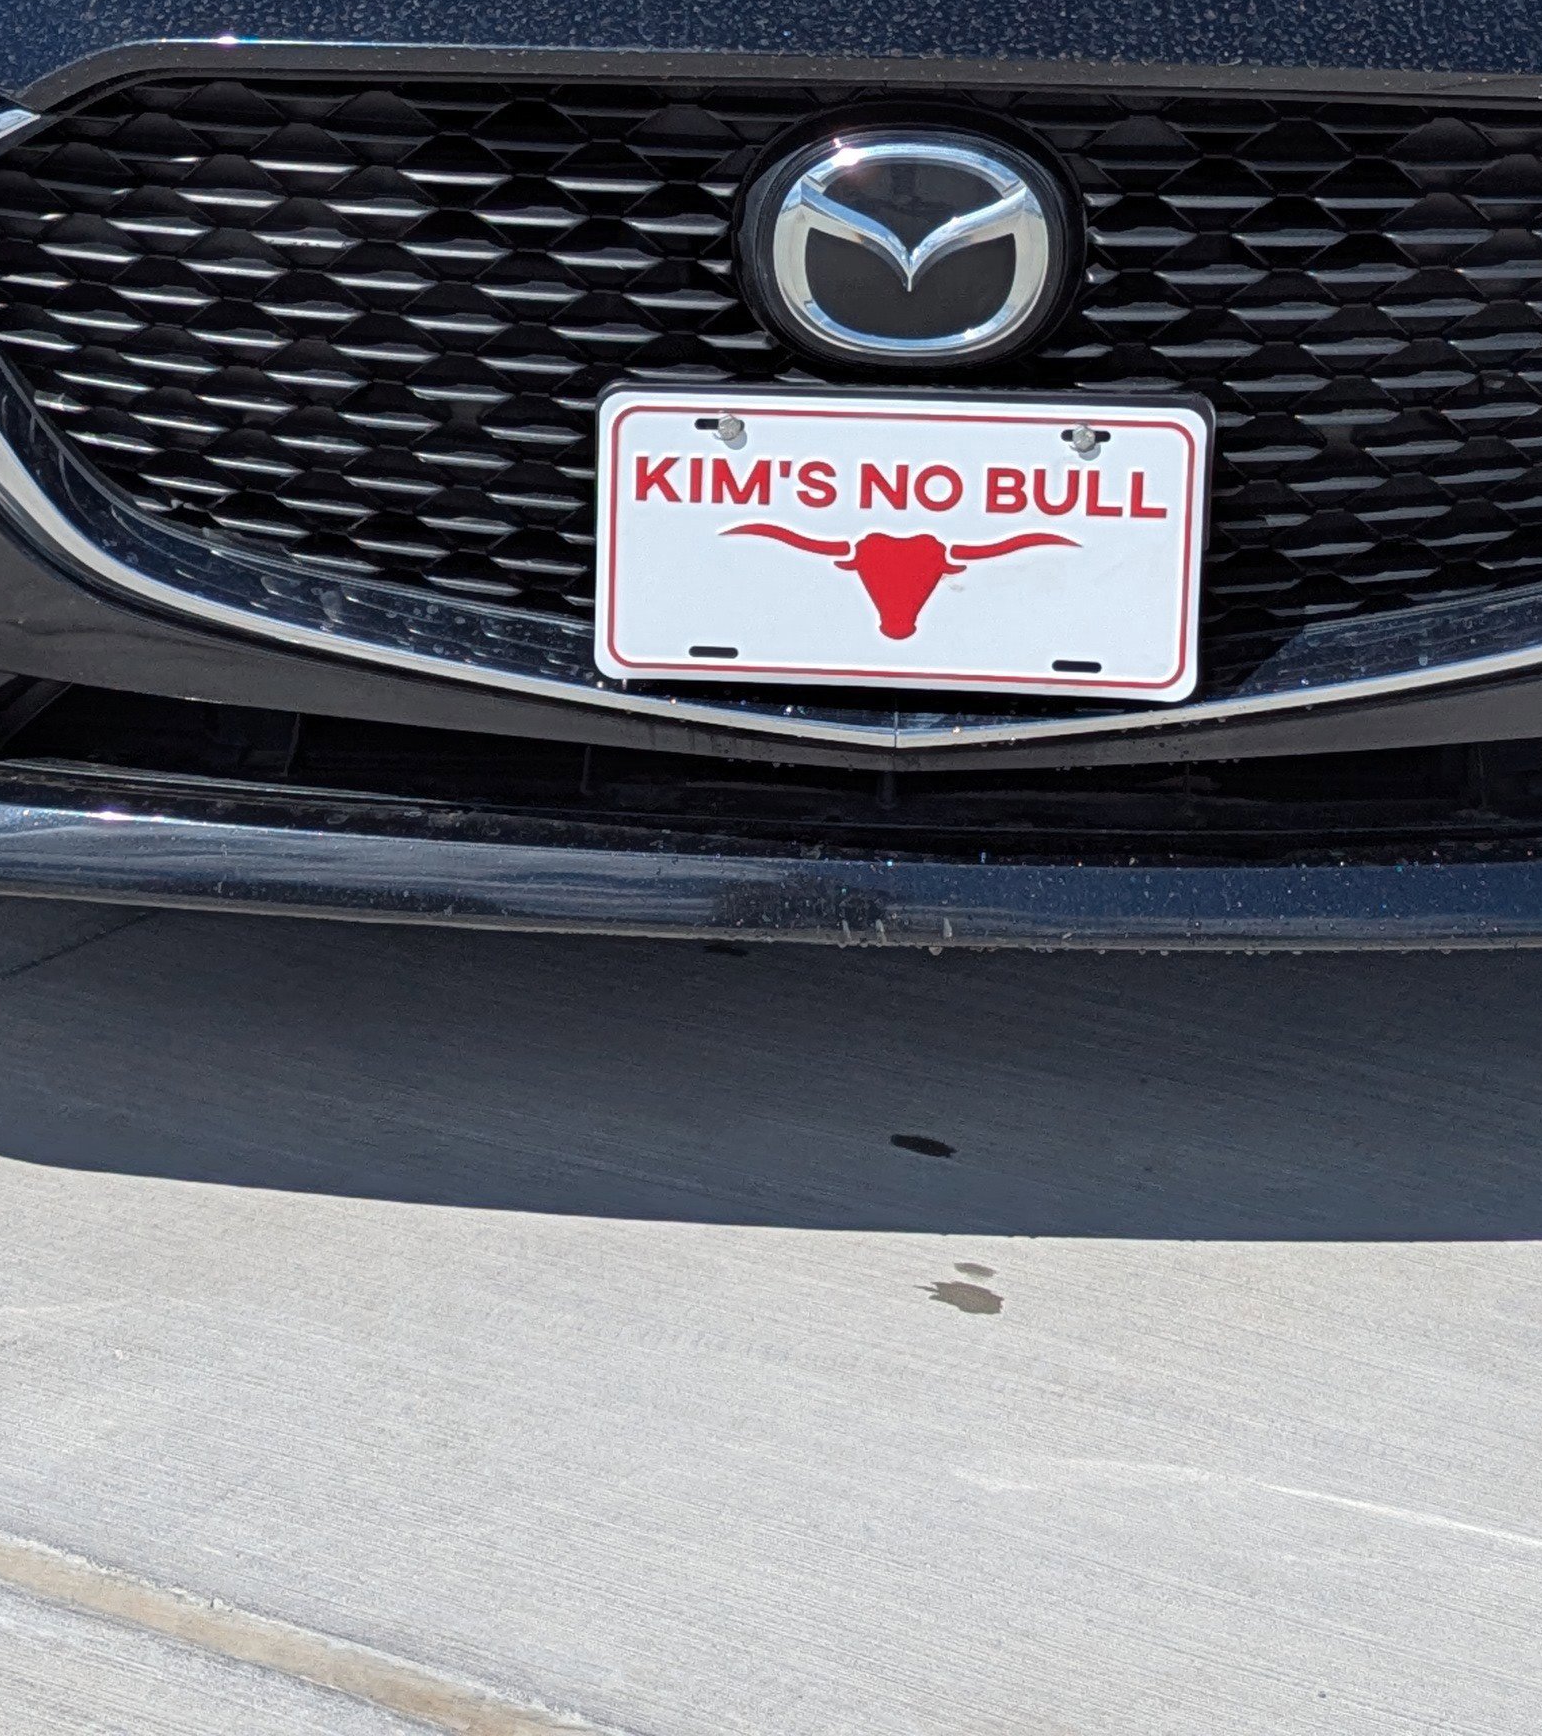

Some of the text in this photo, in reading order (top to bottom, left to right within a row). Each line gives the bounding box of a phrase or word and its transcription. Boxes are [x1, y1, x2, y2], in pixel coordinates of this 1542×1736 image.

[635, 455, 1168, 519] KIM'S NO BULL
